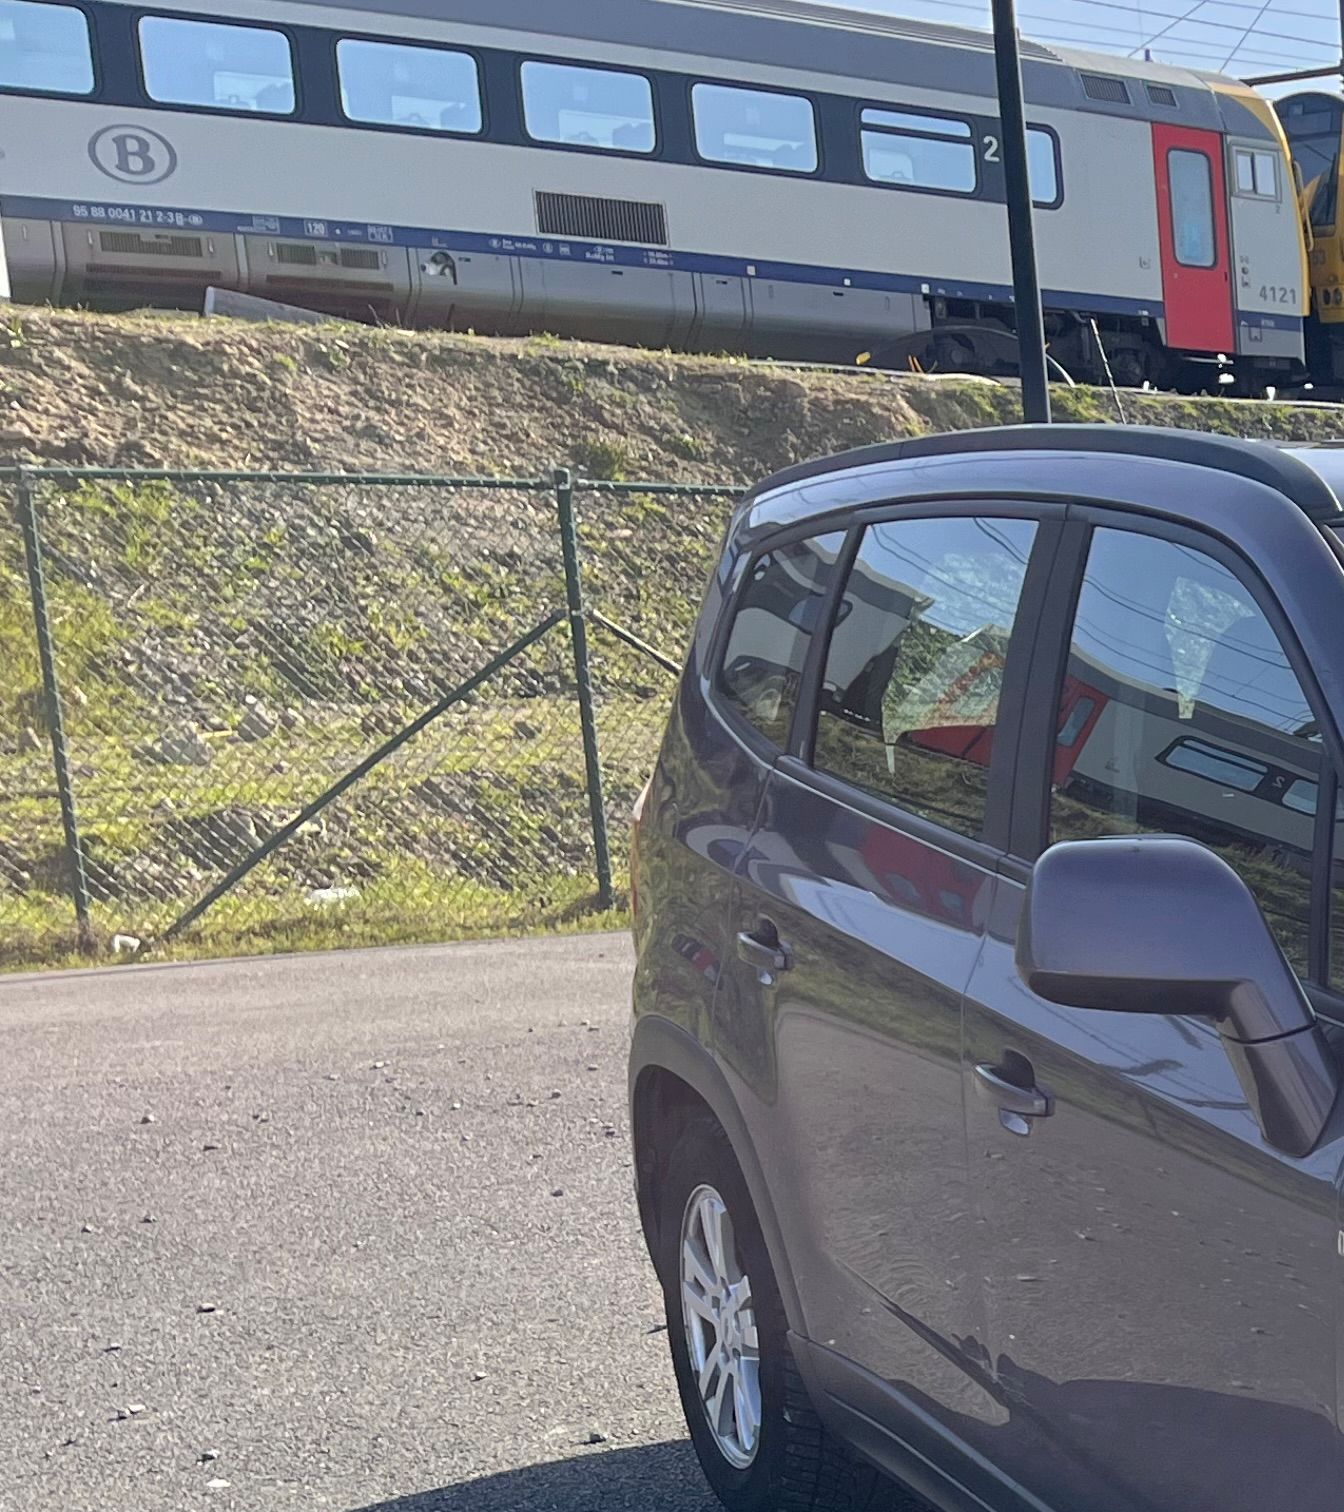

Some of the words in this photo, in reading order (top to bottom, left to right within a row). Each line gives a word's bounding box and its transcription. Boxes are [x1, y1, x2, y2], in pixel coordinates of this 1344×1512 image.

[112, 134, 155, 174] B
[983, 135, 1000, 162] 2
[90, 206, 105, 218] 88
[308, 221, 324, 235] 120
[1259, 285, 1297, 305] 4121
